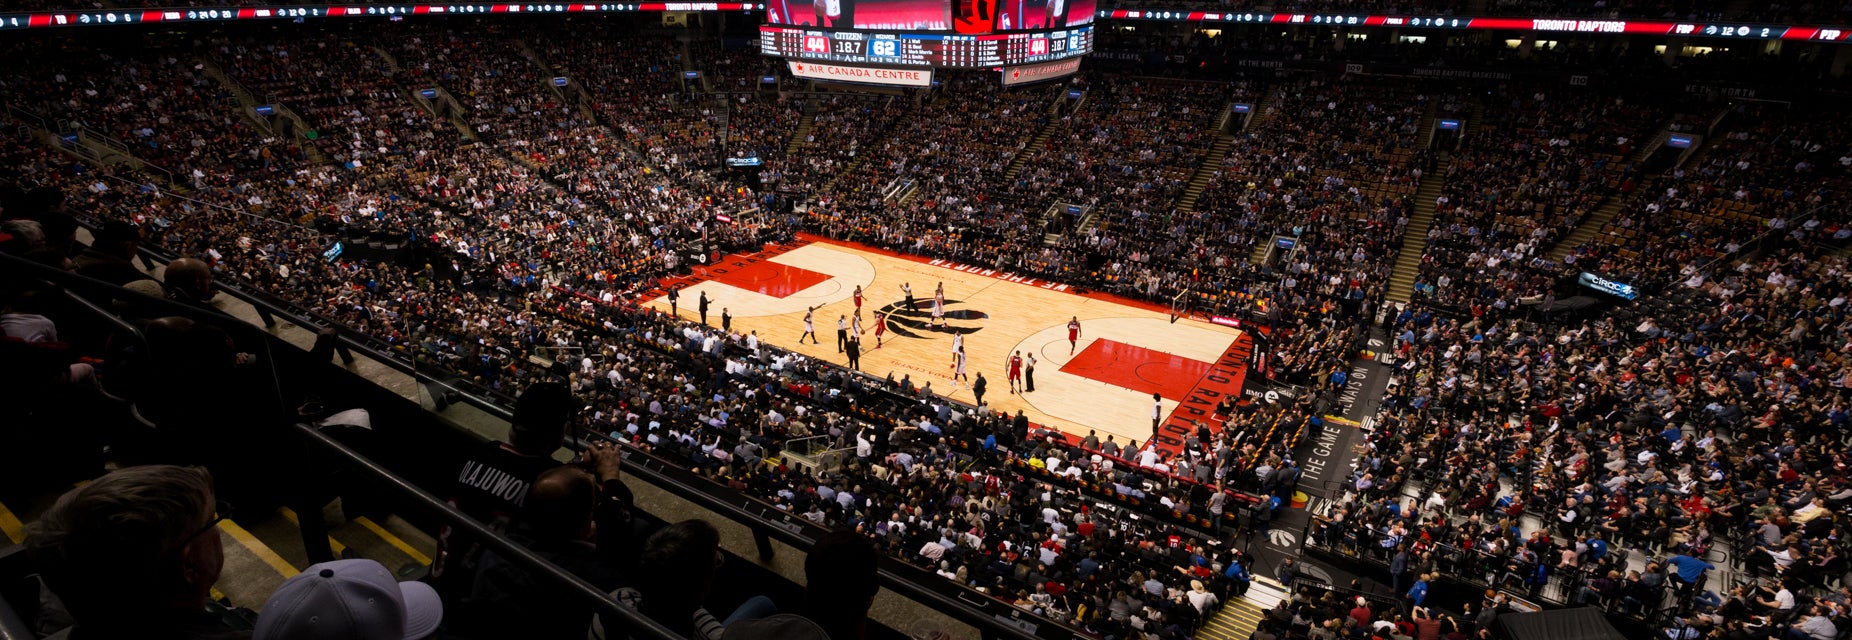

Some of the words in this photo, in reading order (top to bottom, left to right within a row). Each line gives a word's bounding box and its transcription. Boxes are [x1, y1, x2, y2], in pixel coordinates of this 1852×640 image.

[665, 3, 691, 11] TORONTO
[691, 3, 718, 11] RAPTORS
[1292, 15, 1305, 23] AST
[1347, 17, 1358, 25] 20
[1425, 18, 1431, 26] 7
[1532, 19, 1577, 31] TORONTO
[1577, 21, 1625, 32] RAPTORS
[834, 32, 862, 41] CITIZEN
[1720, 26, 1734, 36] 12
[1760, 28, 1770, 38] 2
[1819, 30, 1841, 40] PIP
[807, 37, 825, 52] 44
[835, 42, 861, 54] :18.7
[873, 41, 896, 56] 62
[1031, 40, 1046, 54] 44
[809, 65, 823, 74] AIR
[828, 67, 870, 78] CANADA
[874, 70, 920, 80] CENTRE
[1023, 69, 1036, 77] AIR
[1720, 88, 1756, 98] NORTH
[929, 259, 997, 277] NORTH
[997, 272, 1038, 286] THE
[1041, 281, 1069, 291] WE
[1208, 338, 1253, 385] ORONTO
[1353, 367, 1369, 379] ON
[1245, 389, 1264, 399] BMO
[1313, 426, 1341, 457] GAME
[1301, 457, 1326, 481] THE
